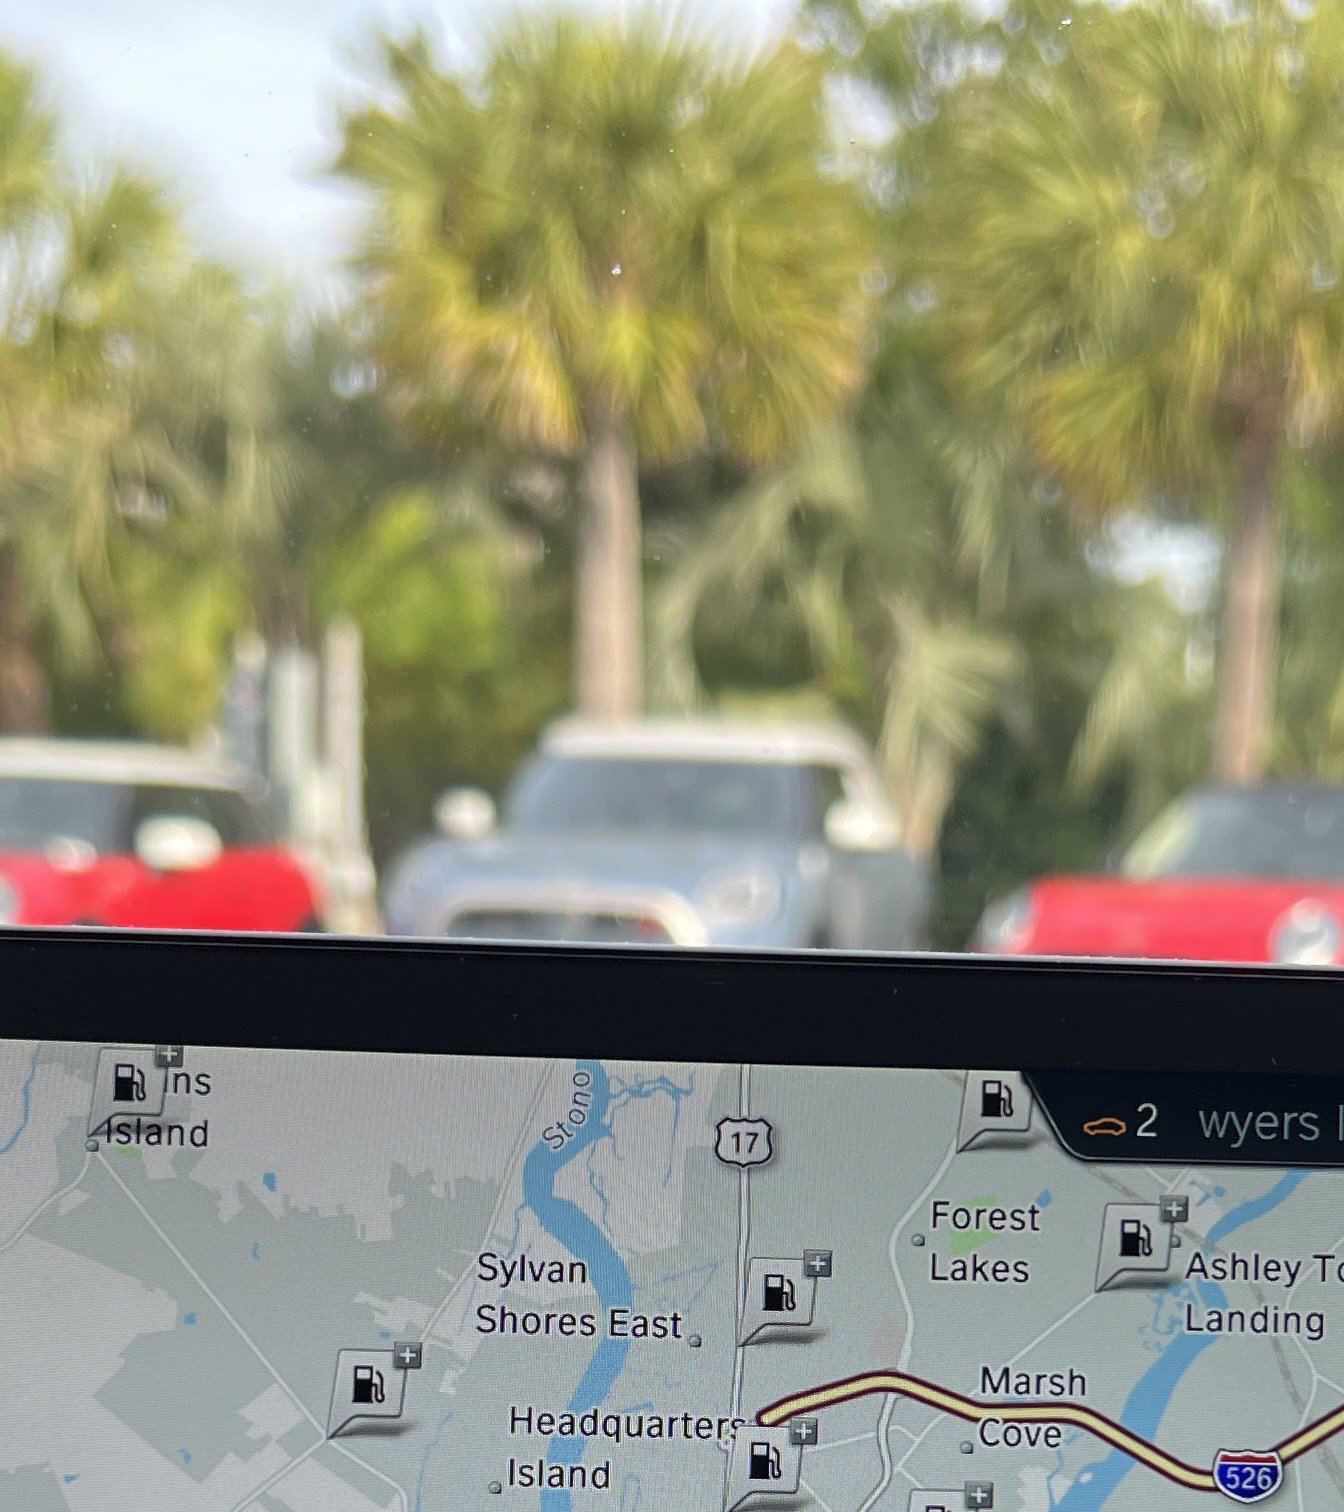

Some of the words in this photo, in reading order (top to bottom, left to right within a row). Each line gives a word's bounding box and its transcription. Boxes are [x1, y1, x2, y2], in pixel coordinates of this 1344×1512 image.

[542, 1070, 591, 1150] Stono
[1136, 1104, 1158, 1138] 2
[1199, 1111, 1320, 1147] wyers
[107, 1117, 208, 1148] Island
[729, 1132, 760, 1155] 17
[931, 1201, 1040, 1231] Forest
[477, 1253, 587, 1290] Sylvan
[930, 1254, 1029, 1283] Lakes
[1185, 1252, 1301, 1287] Ashley
[475, 1305, 596, 1336] Shores
[609, 1310, 683, 1338] East
[1185, 1304, 1325, 1340] Landing
[980, 1366, 1086, 1398] Marsh
[979, 1418, 1062, 1450] Cove
[508, 1458, 610, 1488] Island
[1225, 1465, 1273, 1491] 526
